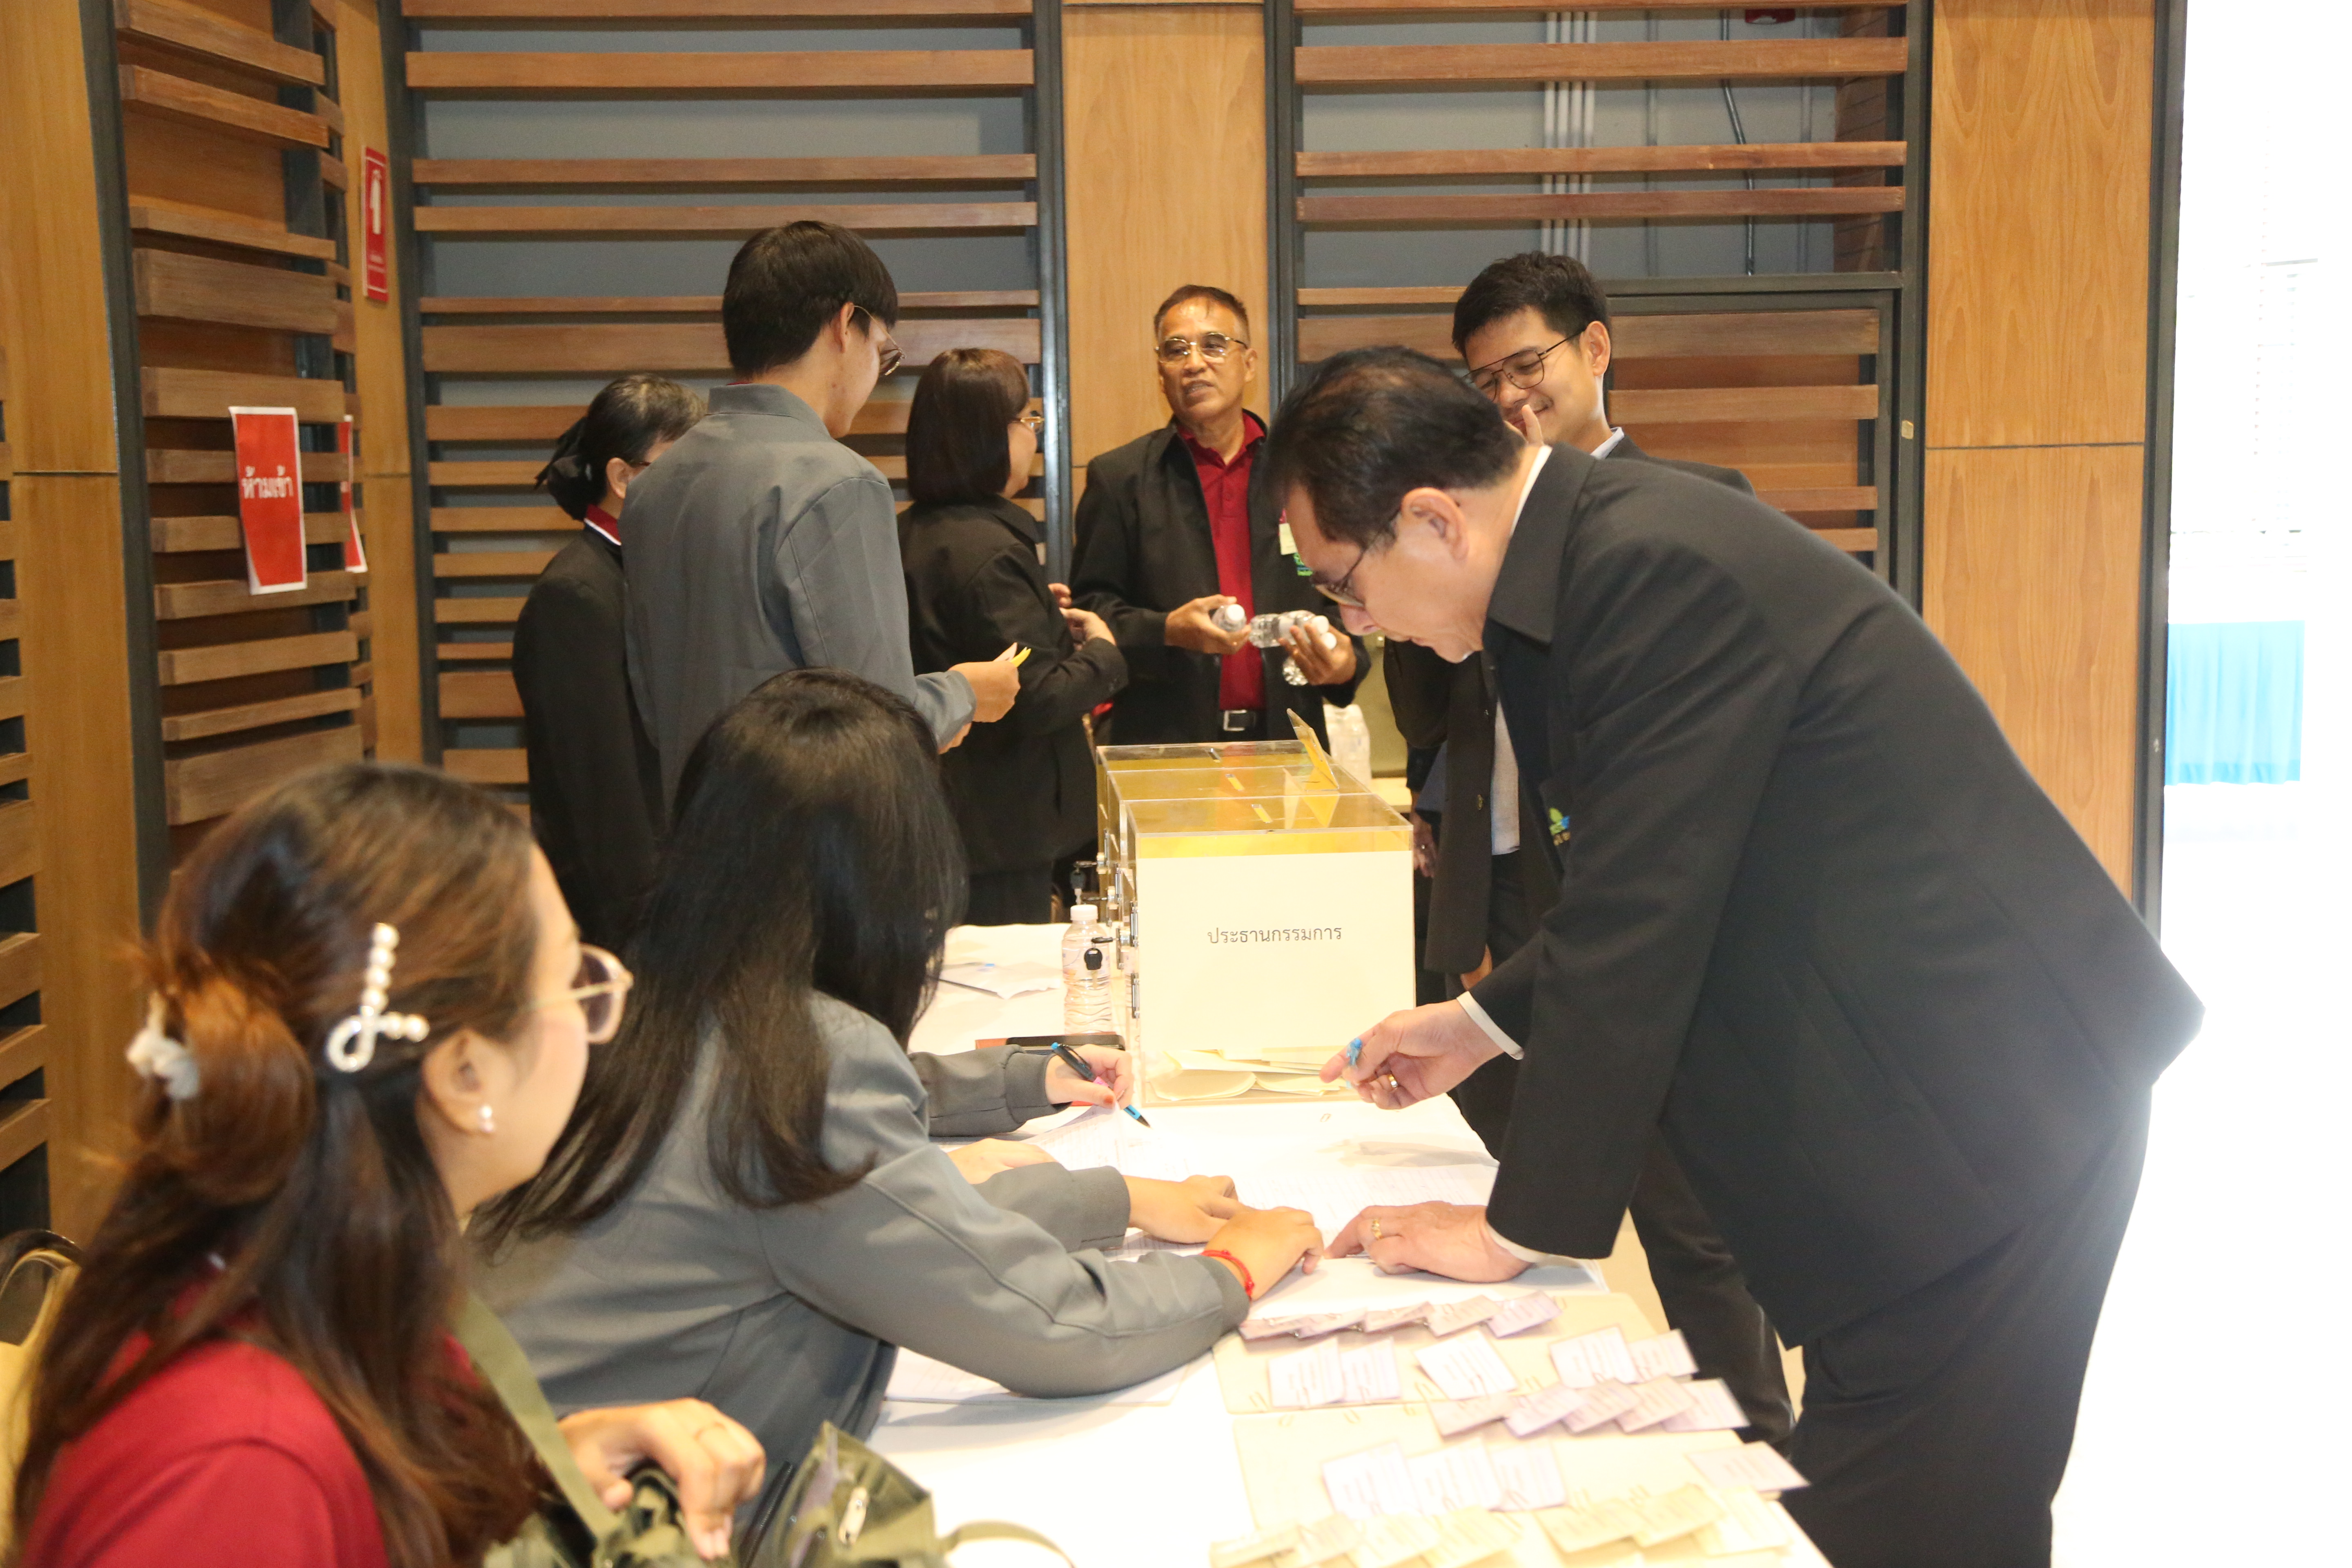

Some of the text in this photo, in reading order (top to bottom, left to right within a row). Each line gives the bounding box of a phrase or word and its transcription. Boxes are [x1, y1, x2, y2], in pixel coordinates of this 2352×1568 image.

[241, 465, 294, 499] ห้ามเข้า
[1207, 927, 1342, 944] ประธานกรรมการ
